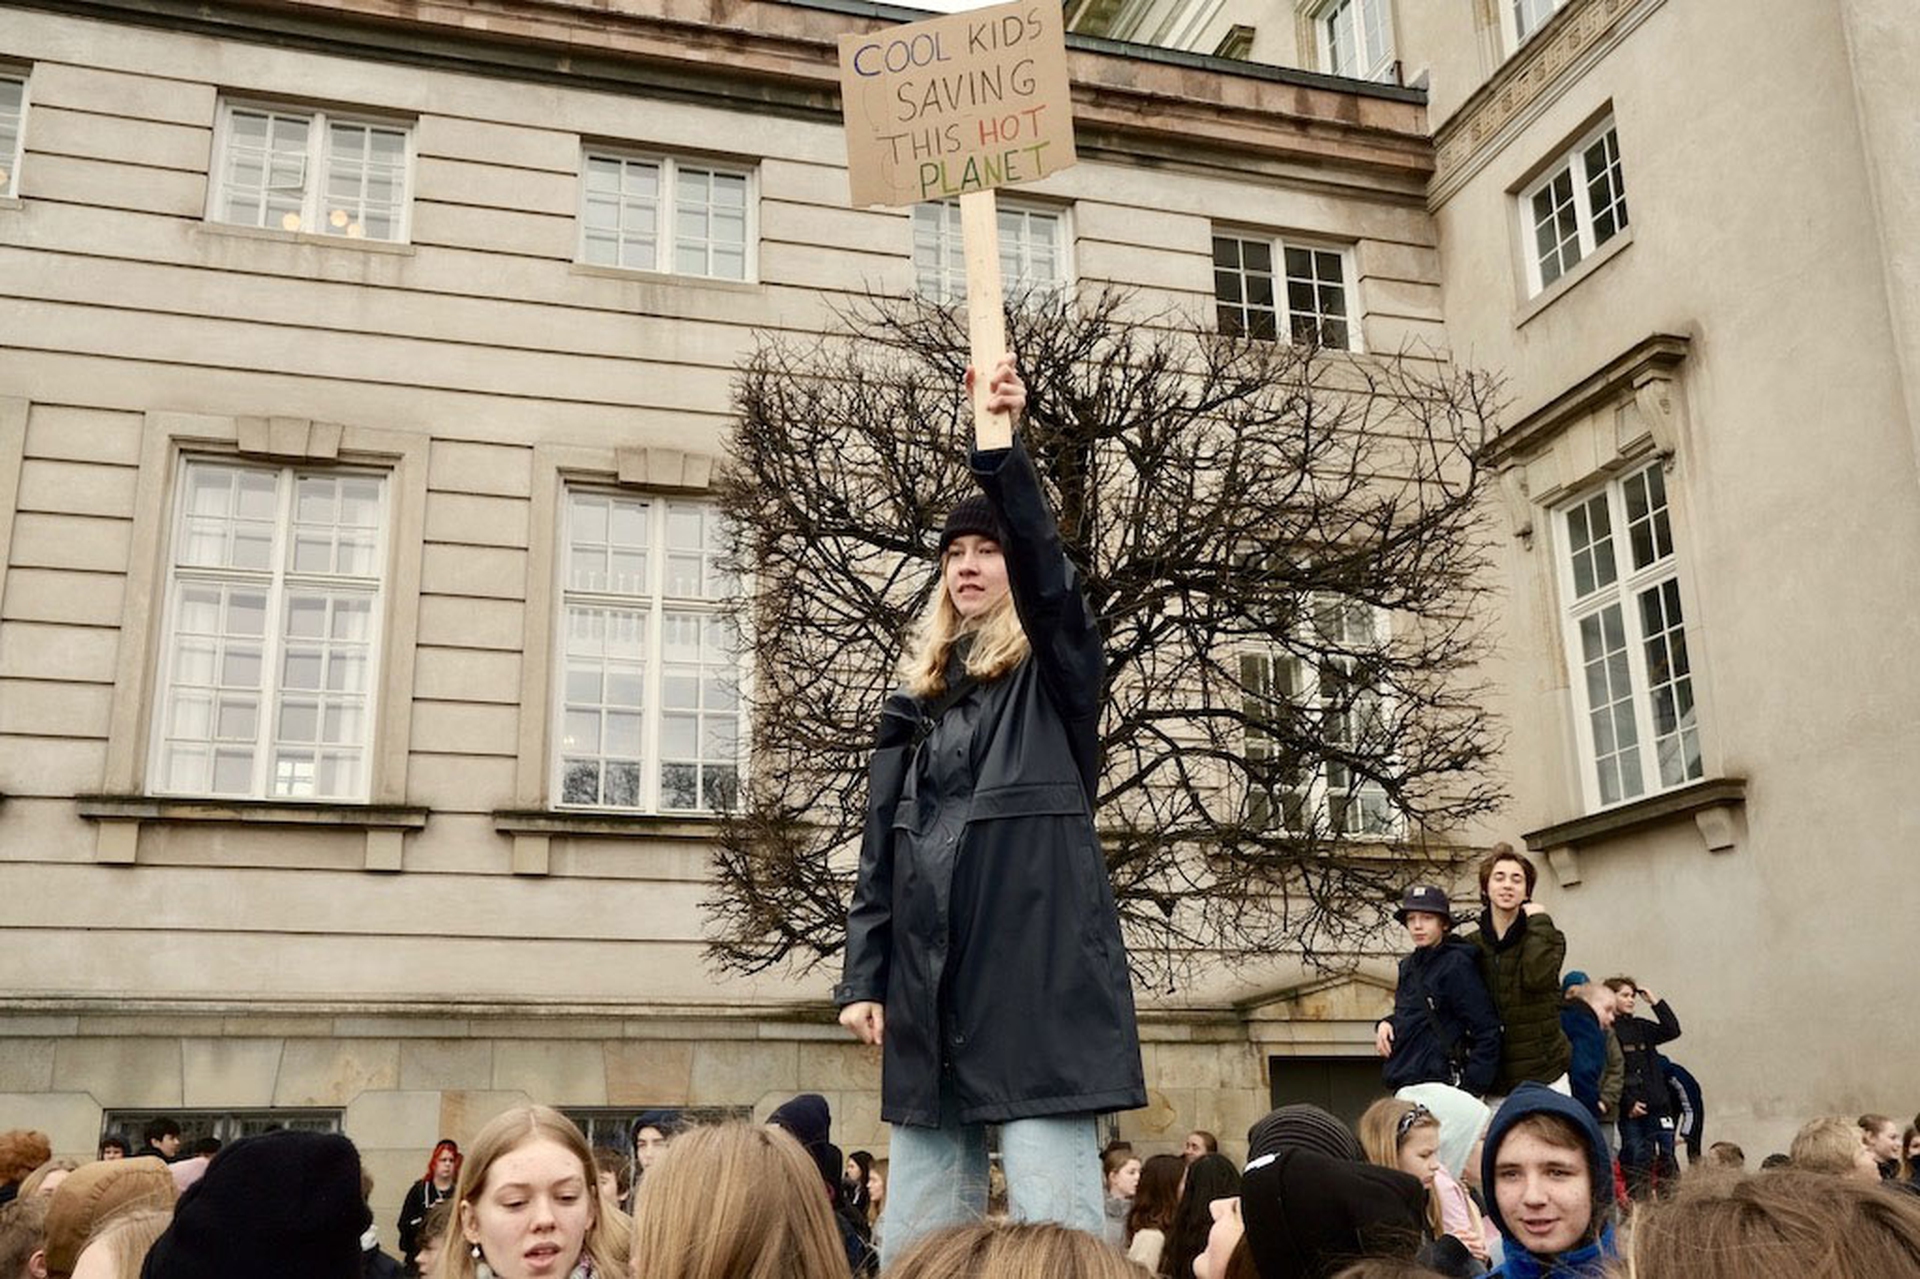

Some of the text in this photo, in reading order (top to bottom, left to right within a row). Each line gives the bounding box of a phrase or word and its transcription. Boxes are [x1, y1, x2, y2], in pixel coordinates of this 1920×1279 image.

[854, 7, 1043, 77] COOL KIDS
[897, 59, 1036, 122] SAVING
[876, 105, 1046, 164] THIS HOT
[919, 141, 1050, 198] PLANET
